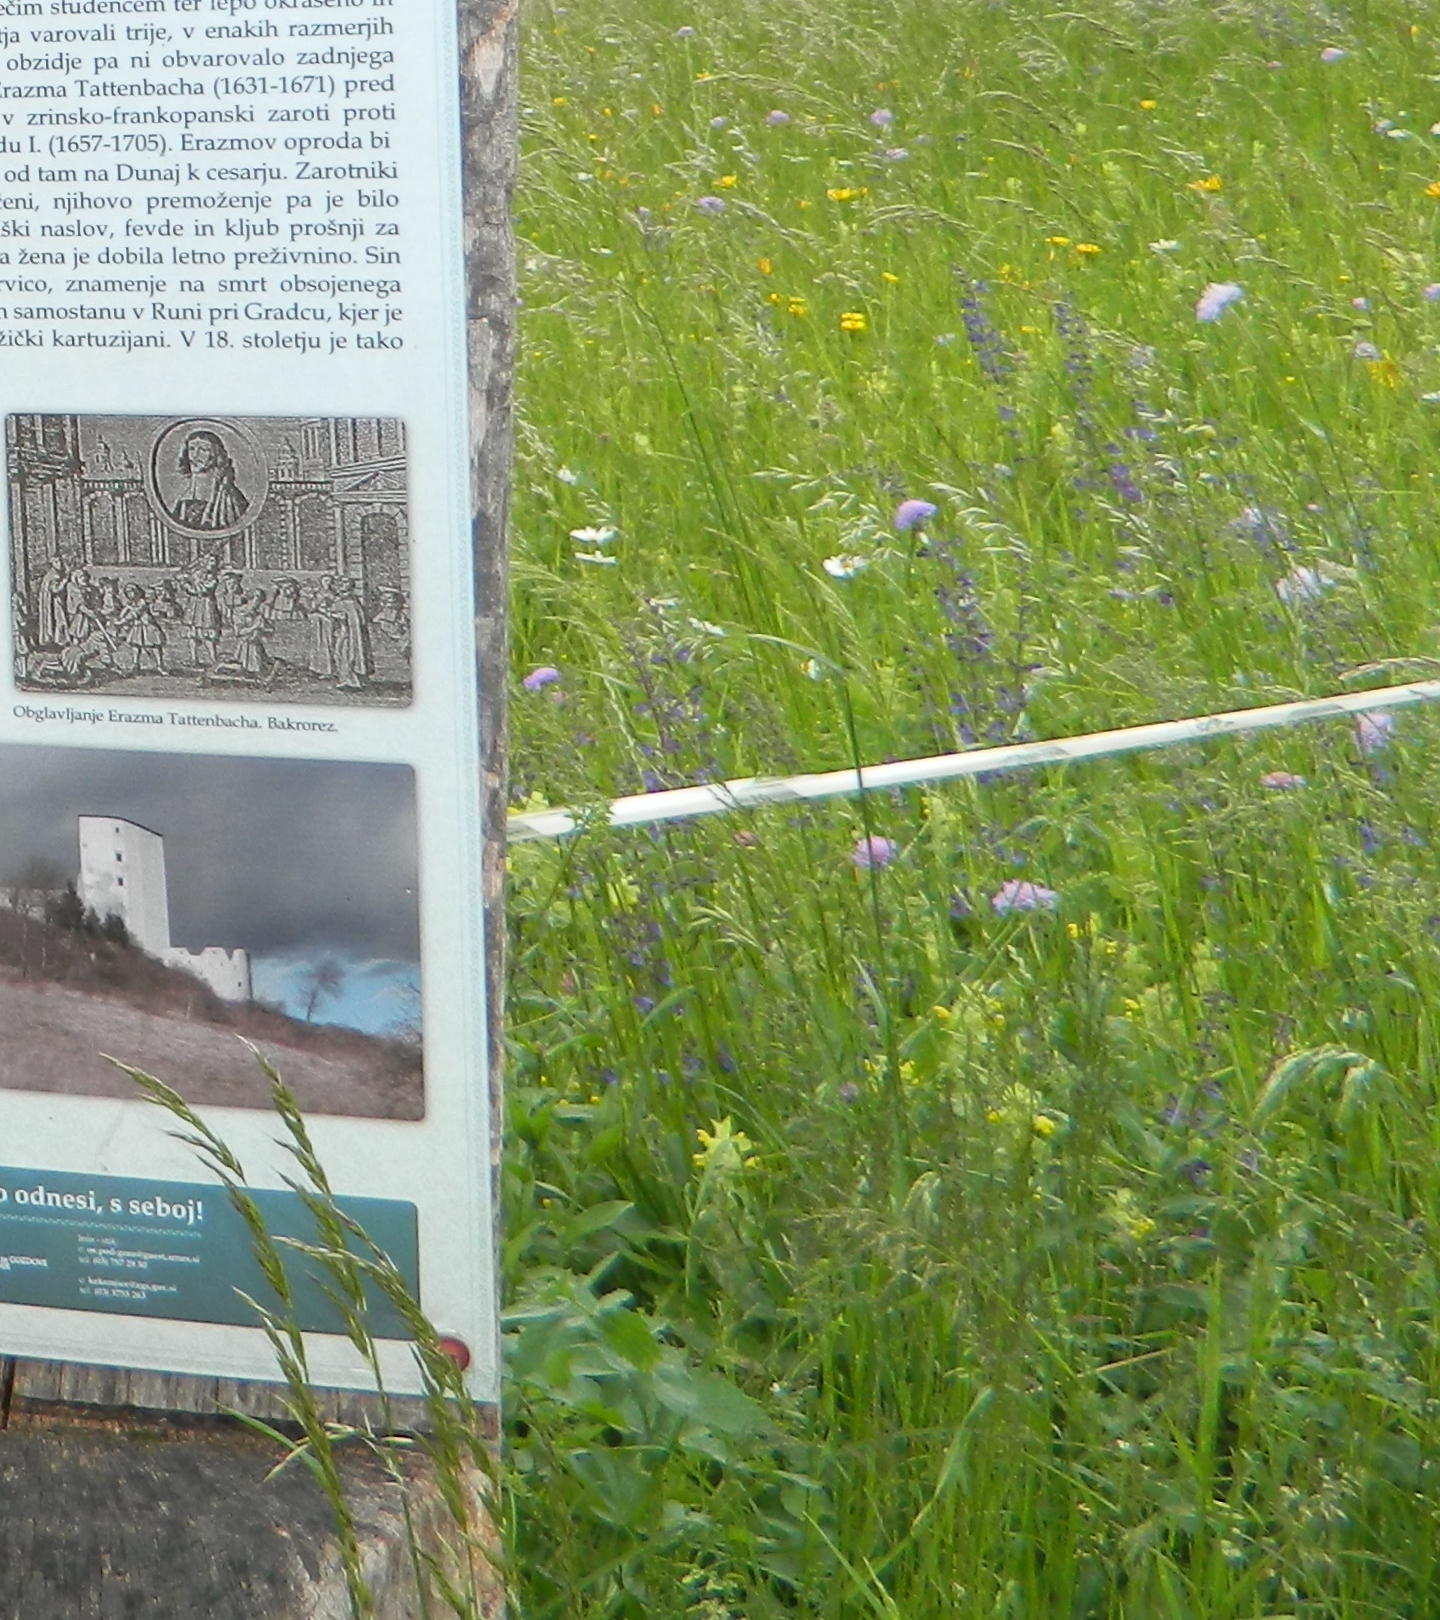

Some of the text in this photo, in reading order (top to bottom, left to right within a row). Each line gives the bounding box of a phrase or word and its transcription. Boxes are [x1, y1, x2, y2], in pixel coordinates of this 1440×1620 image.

[30, 23, 116, 43] varovali
[204, 19, 279, 39] enakih
[288, 16, 394, 42] razmerjih
[6, 52, 82, 76] obzidje
[162, 47, 285, 68] obvarovalo
[296, 45, 395, 70] zadnjega
[73, 77, 205, 98] Tattenbacha
[213, 74, 336, 101] (1631-1671)
[26, 104, 255, 130] zrinsko-frankopanski
[267, 103, 330, 122] zaroti
[343, 102, 396, 127] proti
[48, 133, 173, 159] (1657-1705).
[180, 133, 277, 152] Erazmov
[283, 130, 363, 156] oproda
[116, 163, 180, 187] Dunaj
[206, 162, 288, 186] cesarju.
[295, 160, 399, 180] Zarotniki
[53, 191, 133, 216] njihovo
[146, 190, 272, 215] premoženje
[40, 219, 115, 240] naslov,
[125, 218, 184, 237] fevde
[224, 217, 280, 243] kljub
[289, 218, 365, 242] prošnji
[97, 246, 164, 265] dobila
[172, 246, 226, 265] letno
[233, 246, 358, 271] preživnino.
[65, 274, 167, 298] znamenje
[279, 273, 402, 299] obsojenega
[13, 304, 127, 320] samostanu
[243, 301, 332, 323] Gradcu,
[52, 328, 171, 354] kartuzijani.
[242, 330, 321, 355] stoletju
[12, 705, 338, 733] Obglavljanje Erazma Tattenbacha. Bakrorez.
[14, 1185, 103, 1215] odnesi,
[110, 1198, 123, 1214] s
[129, 1196, 203, 1226] seboj!
